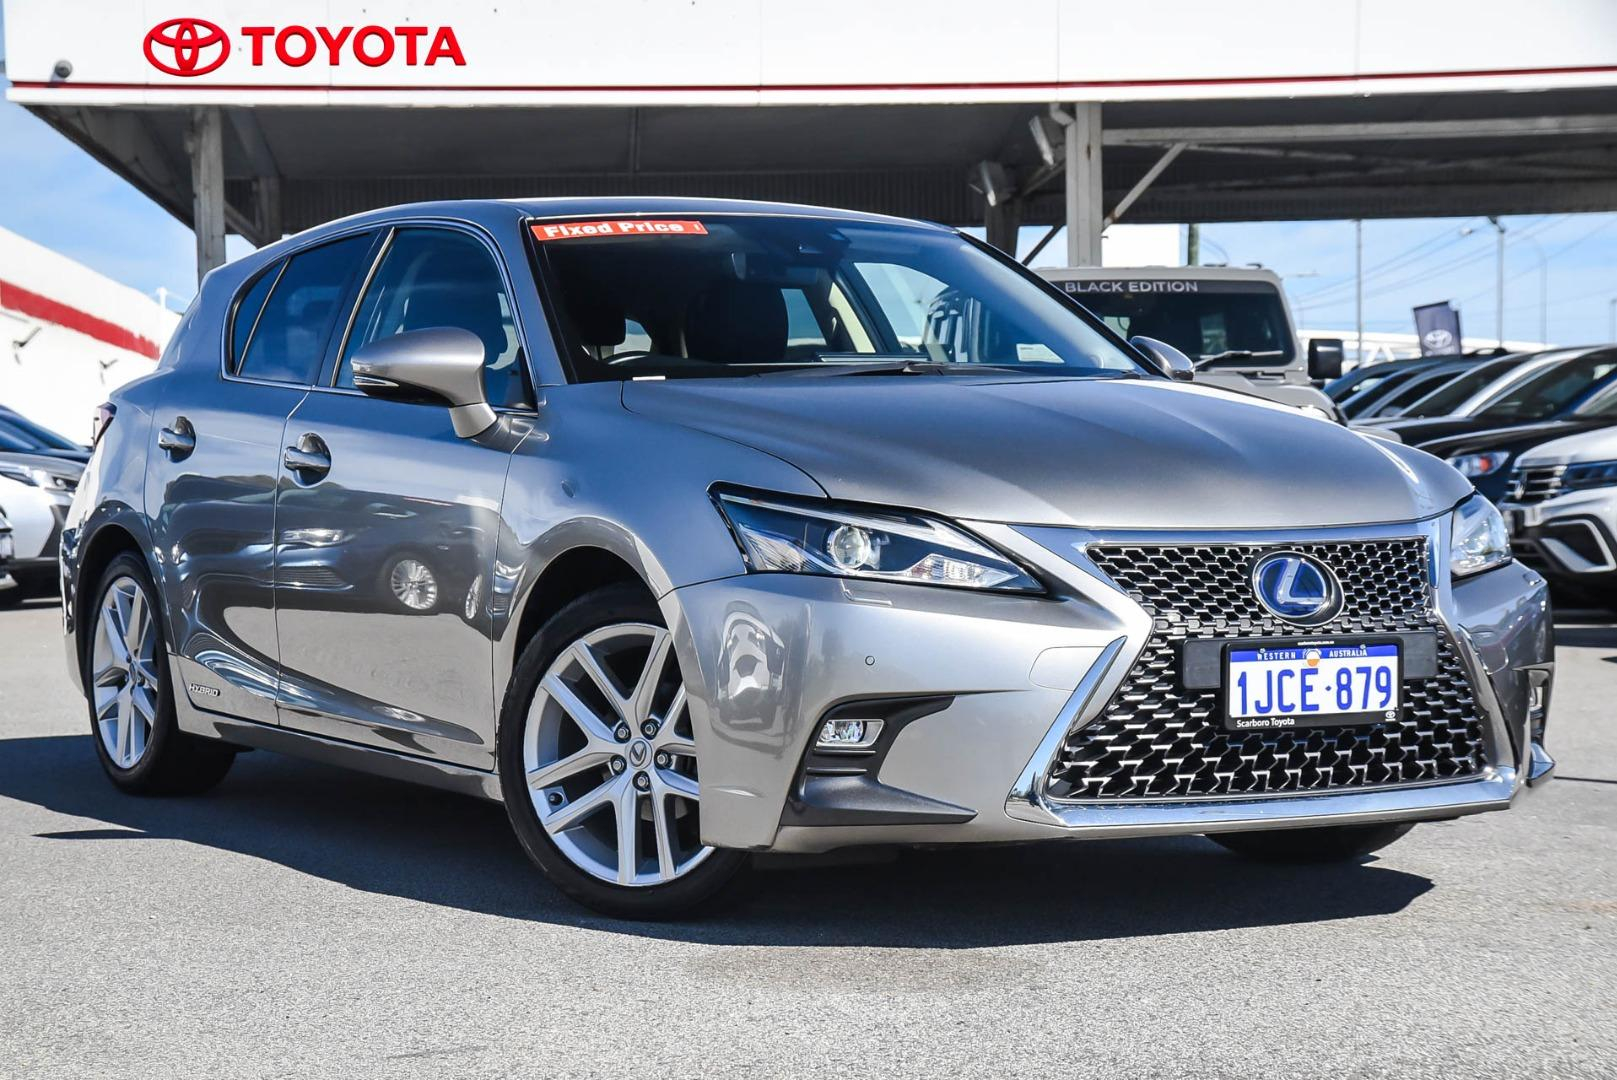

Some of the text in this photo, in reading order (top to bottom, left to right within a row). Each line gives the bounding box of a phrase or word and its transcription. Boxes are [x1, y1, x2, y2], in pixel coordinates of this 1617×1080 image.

[241, 25, 467, 67] TOYOTA
[543, 223, 613, 238] Fixed
[617, 221, 684, 233] Price
[1064, 281, 1199, 293] BLACK EDITION
[1257, 648, 1368, 661] WESTERN AUSTRALIA
[188, 683, 219, 697] HYBRID
[1236, 717, 1295, 728] Scarboro Toyota
